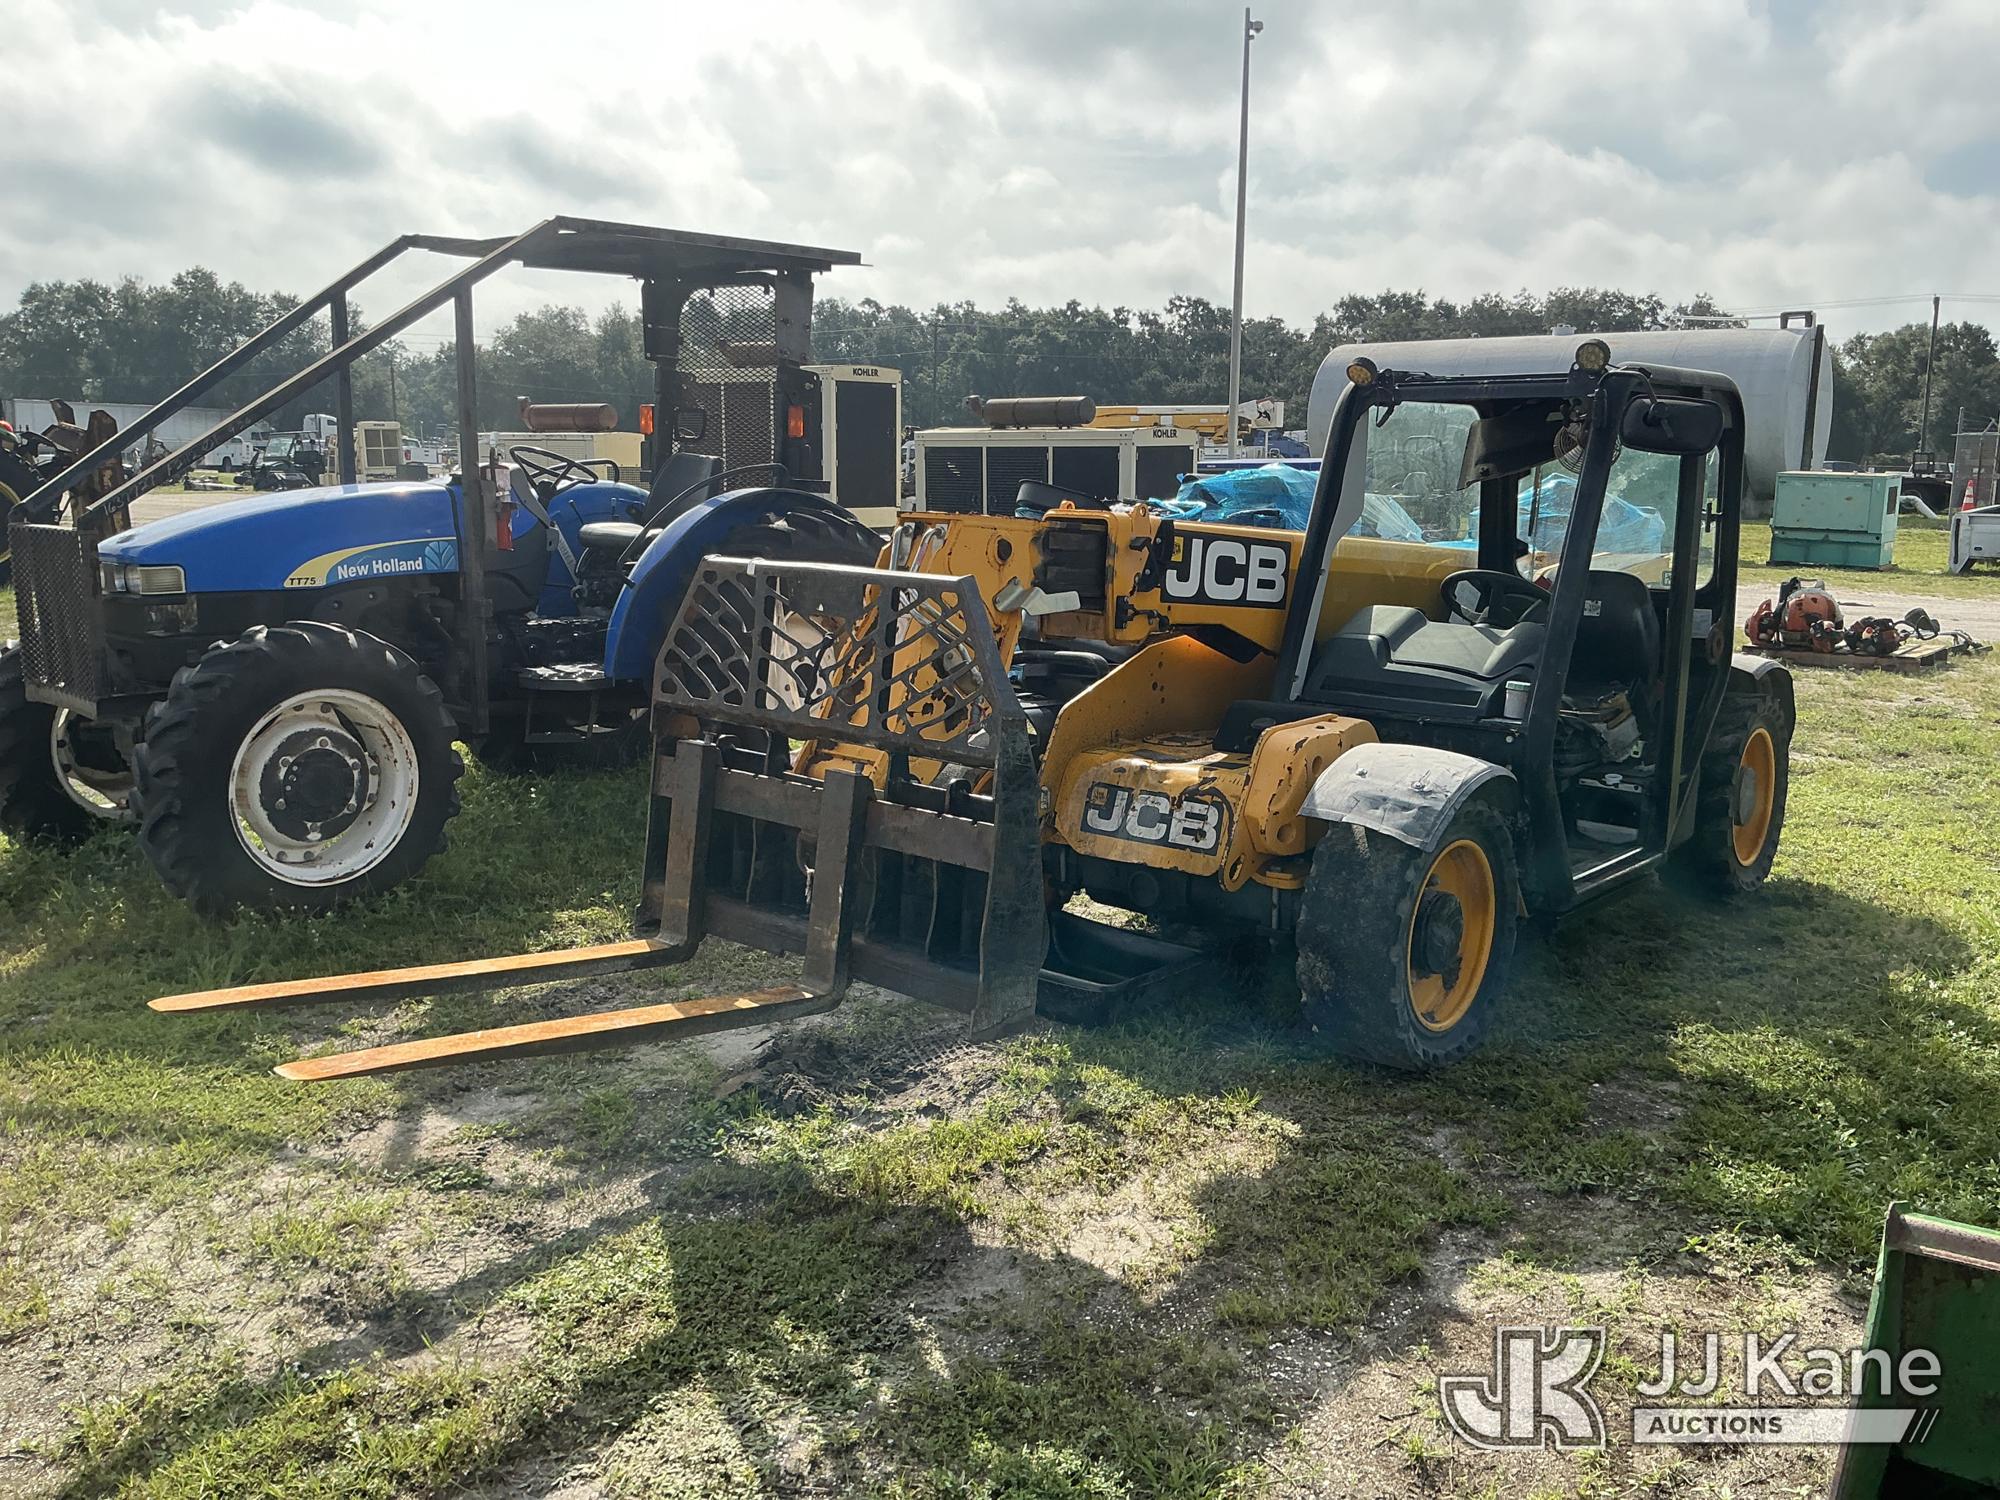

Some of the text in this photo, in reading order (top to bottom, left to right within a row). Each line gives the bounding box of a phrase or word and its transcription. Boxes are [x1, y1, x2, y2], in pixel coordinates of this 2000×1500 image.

[852, 367, 880, 377] KOHLER
[1152, 429, 1178, 439] KOHLER
[337, 557, 423, 580] New Holland
[1165, 538, 1287, 603] JCB
[1086, 790, 1219, 850] JCB
